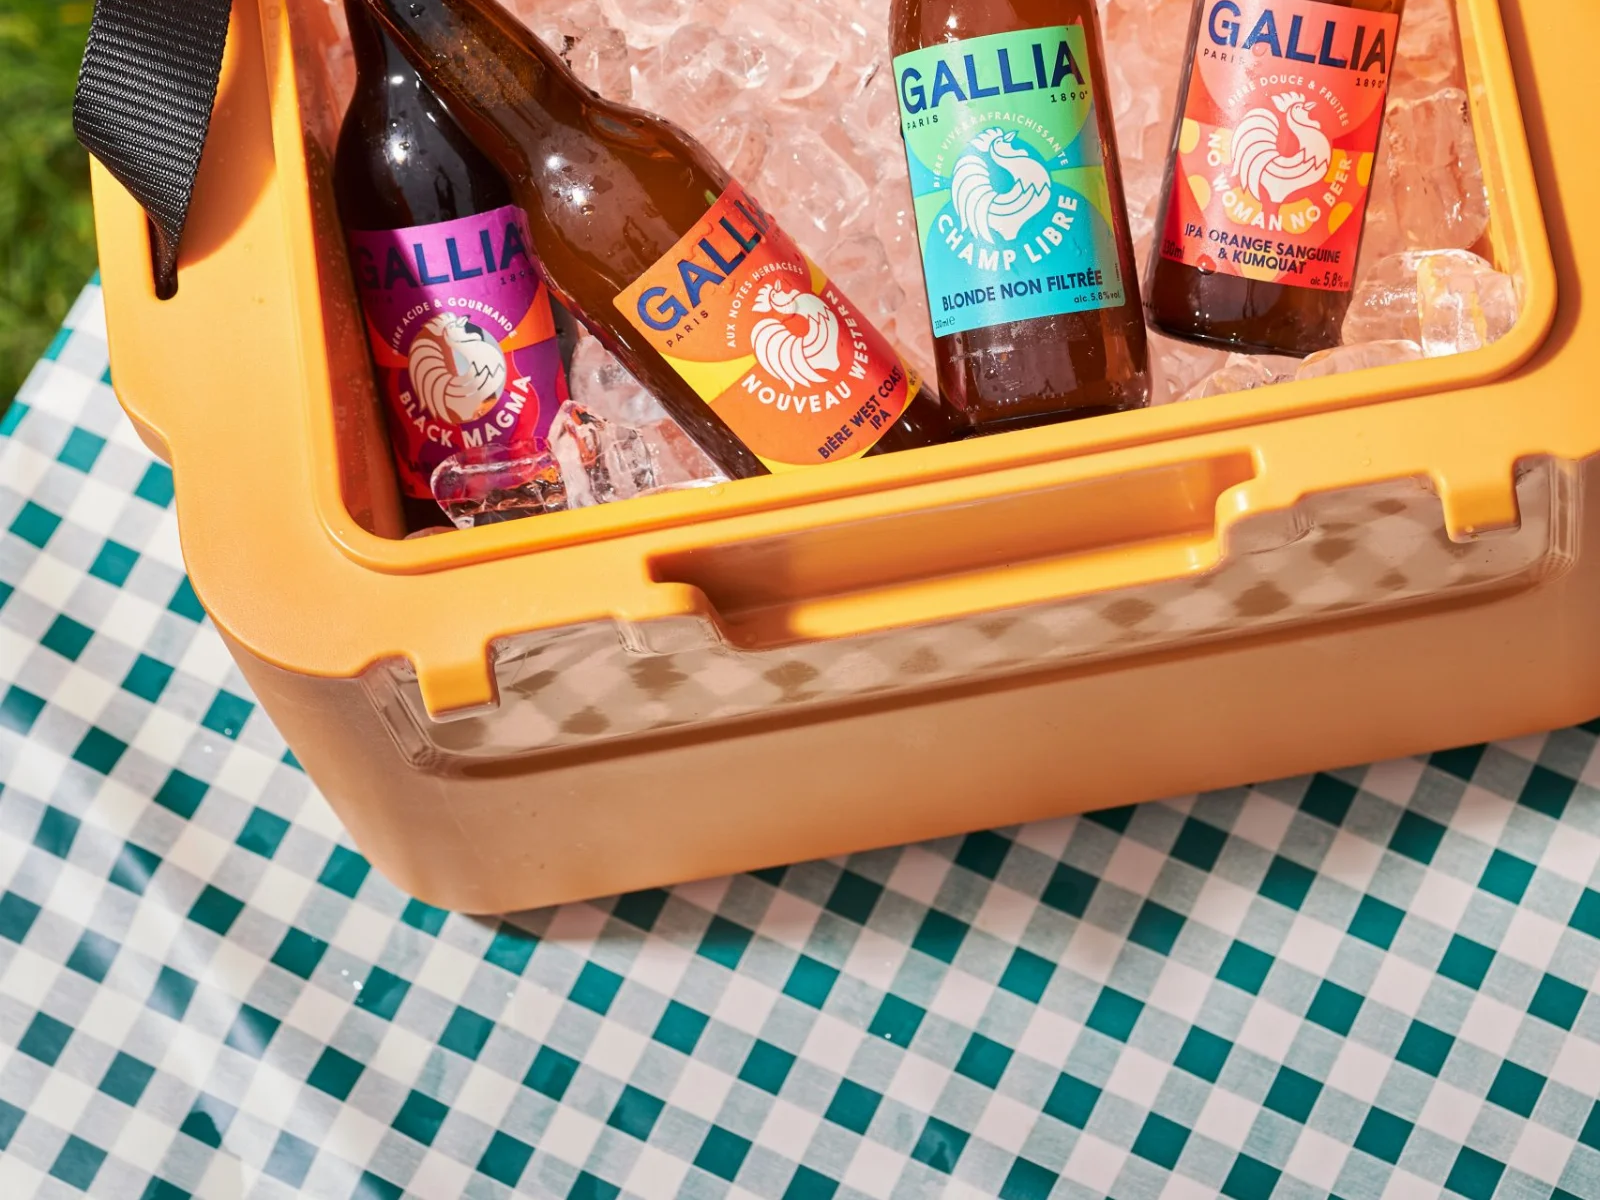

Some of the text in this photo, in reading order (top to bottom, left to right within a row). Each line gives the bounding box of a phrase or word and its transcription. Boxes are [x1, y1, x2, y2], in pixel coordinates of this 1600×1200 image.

[1208, 0, 1386, 74] GALLIA
[900, 40, 1086, 115] GALLIA
[906, 114, 939, 131] PARIS
[1260, 74, 1304, 87] DOUCE
[1308, 80, 1316, 90] &
[1319, 86, 1349, 127] FRUITÉE
[1207, 133, 1353, 232] NO WOMAN NO BEER
[938, 195, 1078, 271] CHAMP LIBRE
[1184, 223, 1341, 264] IPA ORANGE SANGUINE
[356, 222, 528, 290] GALLIA
[752, 261, 804, 281] HERBACÉES
[1217, 247, 1307, 275] & KUMQUAT
[729, 280, 752, 319] NOTES
[942, 286, 996, 311] BLONDE
[1000, 278, 1042, 300] NON
[1046, 267, 1103, 292] FILTRÉE
[402, 302, 431, 326] ACIDE
[434, 298, 442, 308] &
[447, 297, 518, 339] GOURMANDE
[666, 310, 708, 347] PARIS
[726, 323, 737, 347] AUX
[741, 290, 870, 414] NOUVEAU WESTERN
[400, 376, 532, 449] BLACK MAGMA
[818, 365, 904, 459] BIÈRE WEST COAST
[869, 408, 891, 430] IPA
